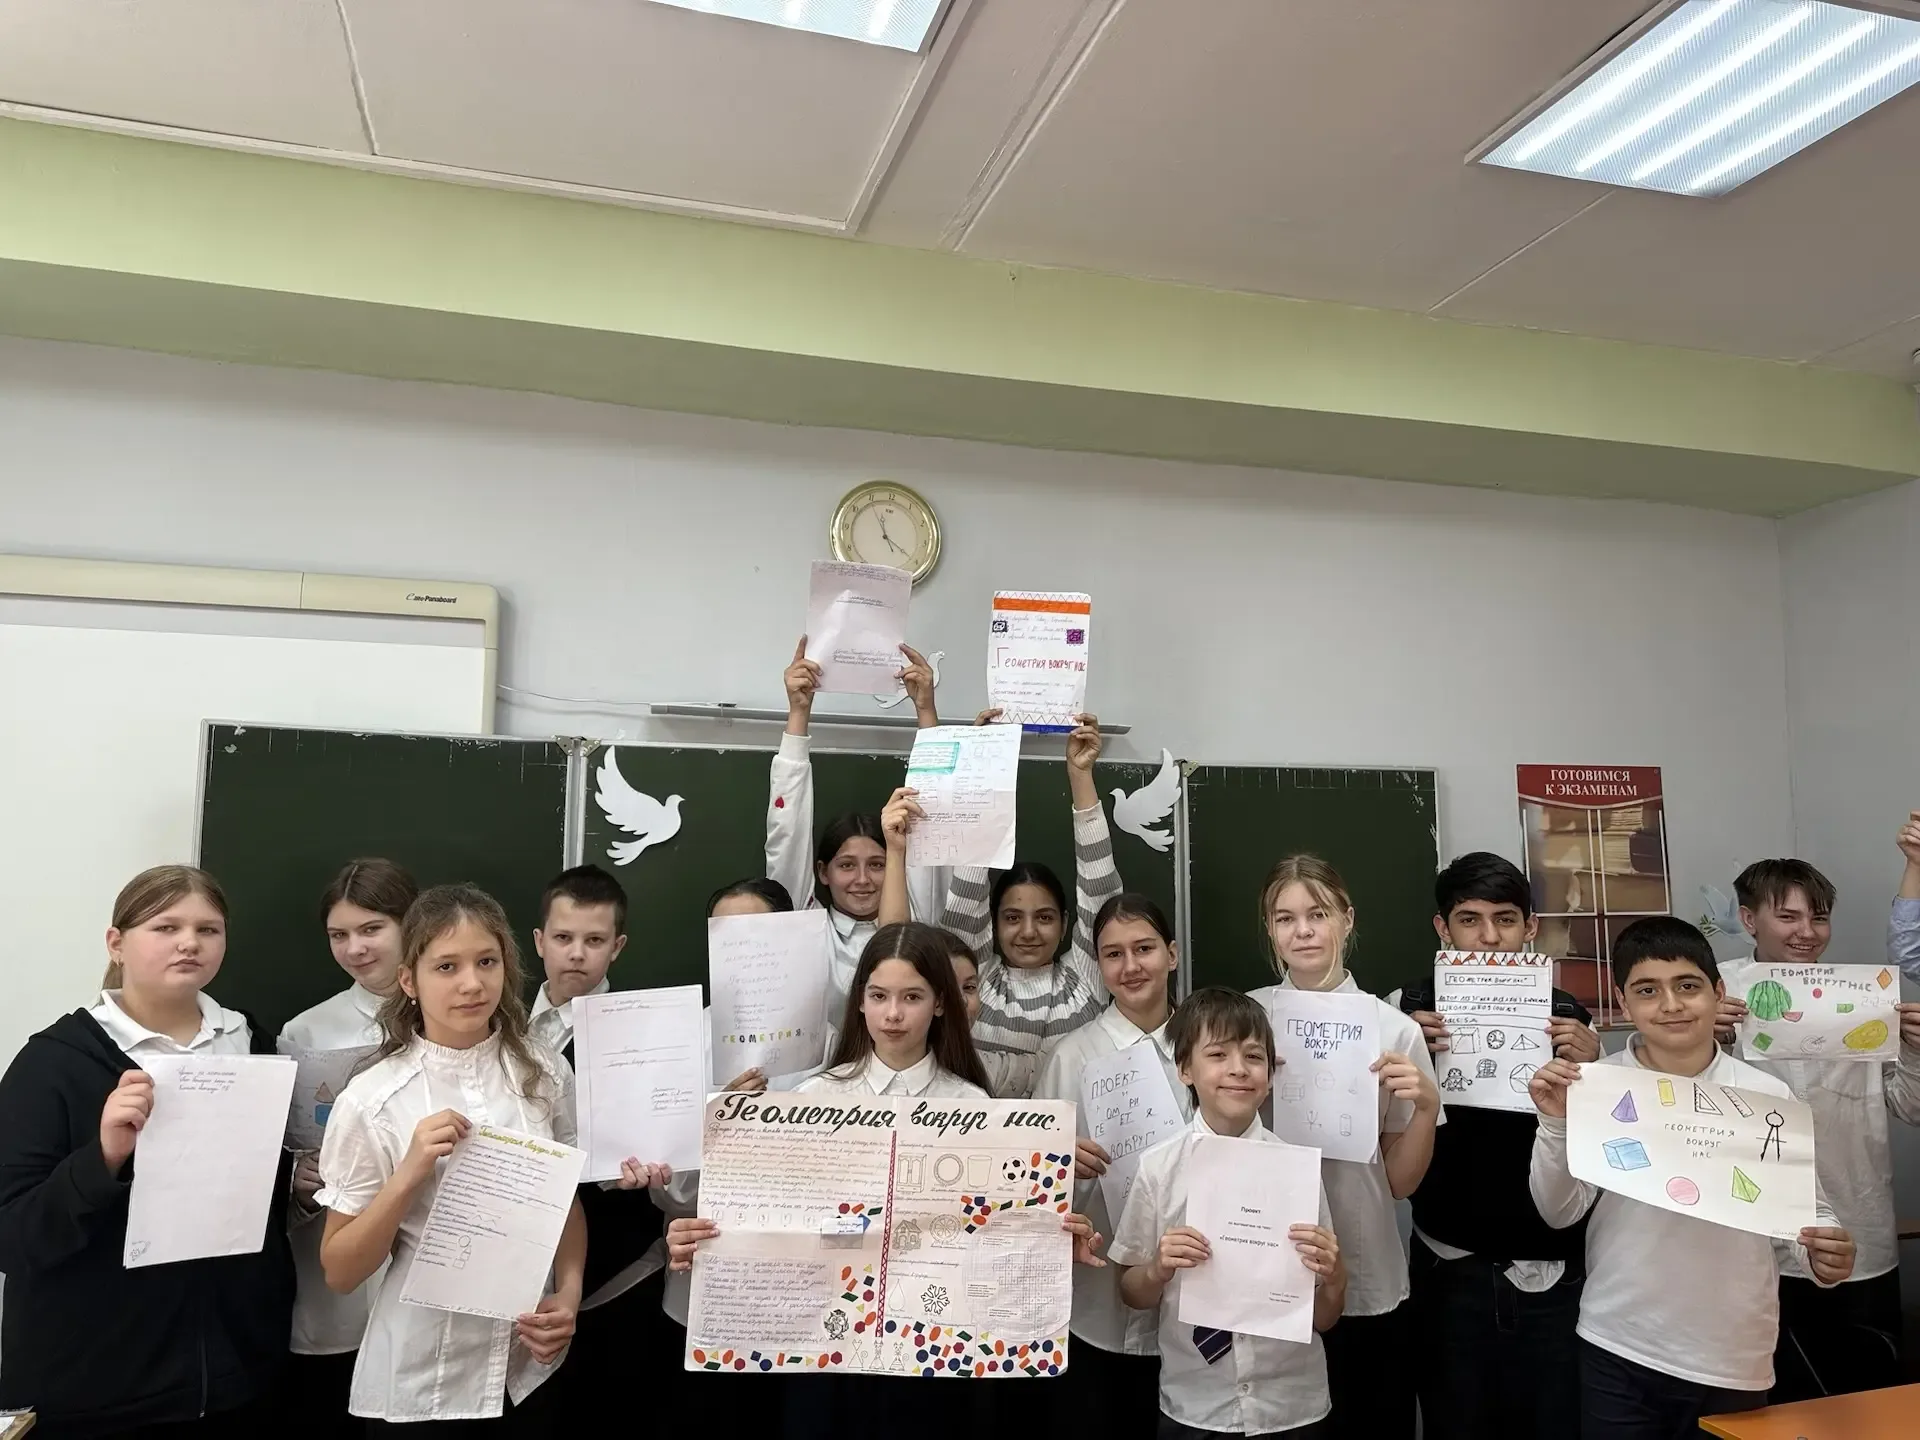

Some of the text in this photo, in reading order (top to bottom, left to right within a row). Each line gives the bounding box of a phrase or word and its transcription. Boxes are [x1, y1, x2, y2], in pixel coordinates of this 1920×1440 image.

[888, 493, 896, 501] 12
[1551, 769, 1631, 782] ГОТОВИМСЯ
[1545, 784, 1638, 796] К ЭКЗАМЕНАМ
[1770, 967, 1835, 978] ГЕОМЕТРИЯ
[1803, 977, 1872, 992] ВОКРУГ НАС
[1287, 1019, 1364, 1041] ГЕОМЕТРИЯ
[1304, 1037, 1342, 1051] ВОКРУГ
[1313, 1050, 1328, 1060] НАС
[1091, 1070, 1139, 1100] ПРОЕКТ
[715, 1091, 896, 1132] Геометрия
[911, 1101, 988, 1138] вокруг
[1003, 1111, 1061, 1131] нас.
[1664, 1123, 1735, 1137] ГЕОМЕТРИЯ
[1686, 1138, 1722, 1148] ВОКРУГ
[1692, 1151, 1712, 1159] НАС
[1241, 1206, 1261, 1214] Проект
